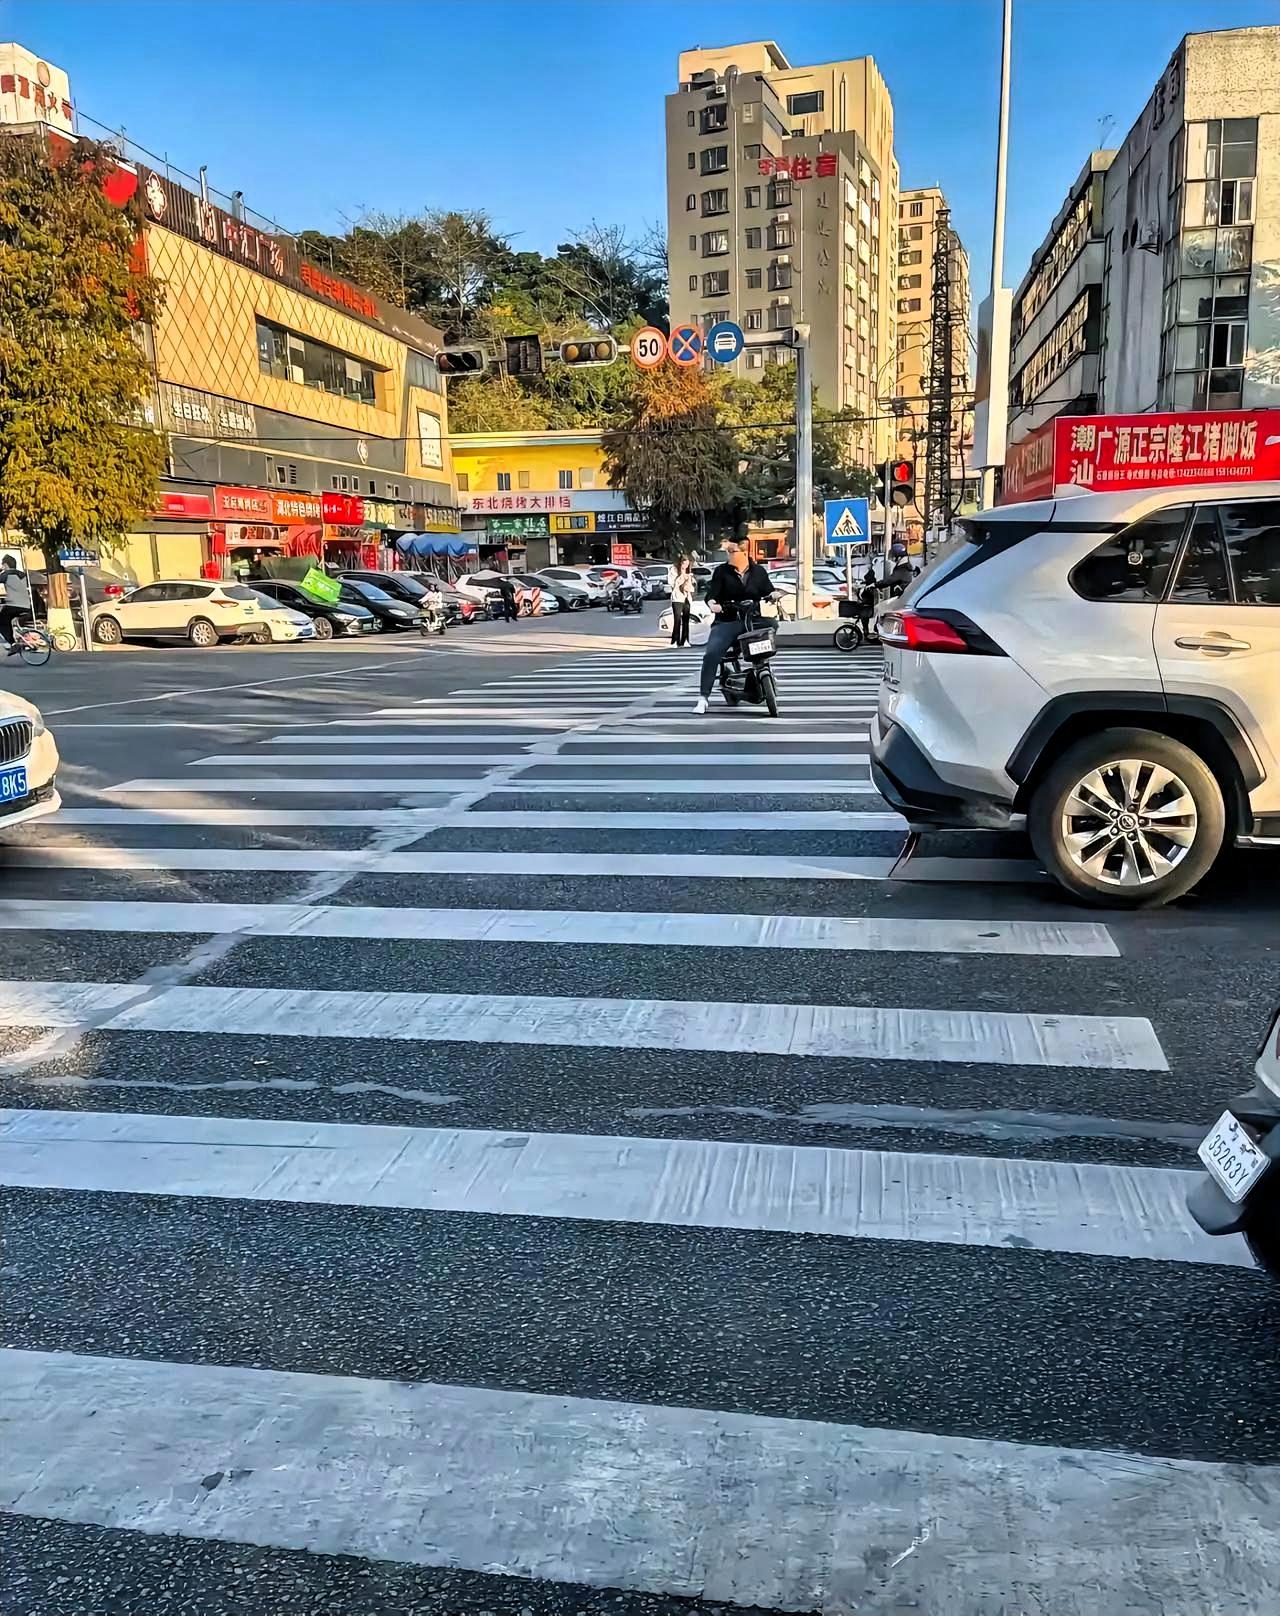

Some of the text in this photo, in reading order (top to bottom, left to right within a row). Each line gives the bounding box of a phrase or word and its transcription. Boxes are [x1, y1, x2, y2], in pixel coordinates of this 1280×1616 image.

[638, 339, 659, 358] 50
[1096, 420, 1258, 465] 广源正宗隆江猪脚饭
[472, 495, 571, 510] 东北烧烤大排档
[0, 772, 26, 798] 8K5
[1208, 1134, 1249, 1186] 35263Y
